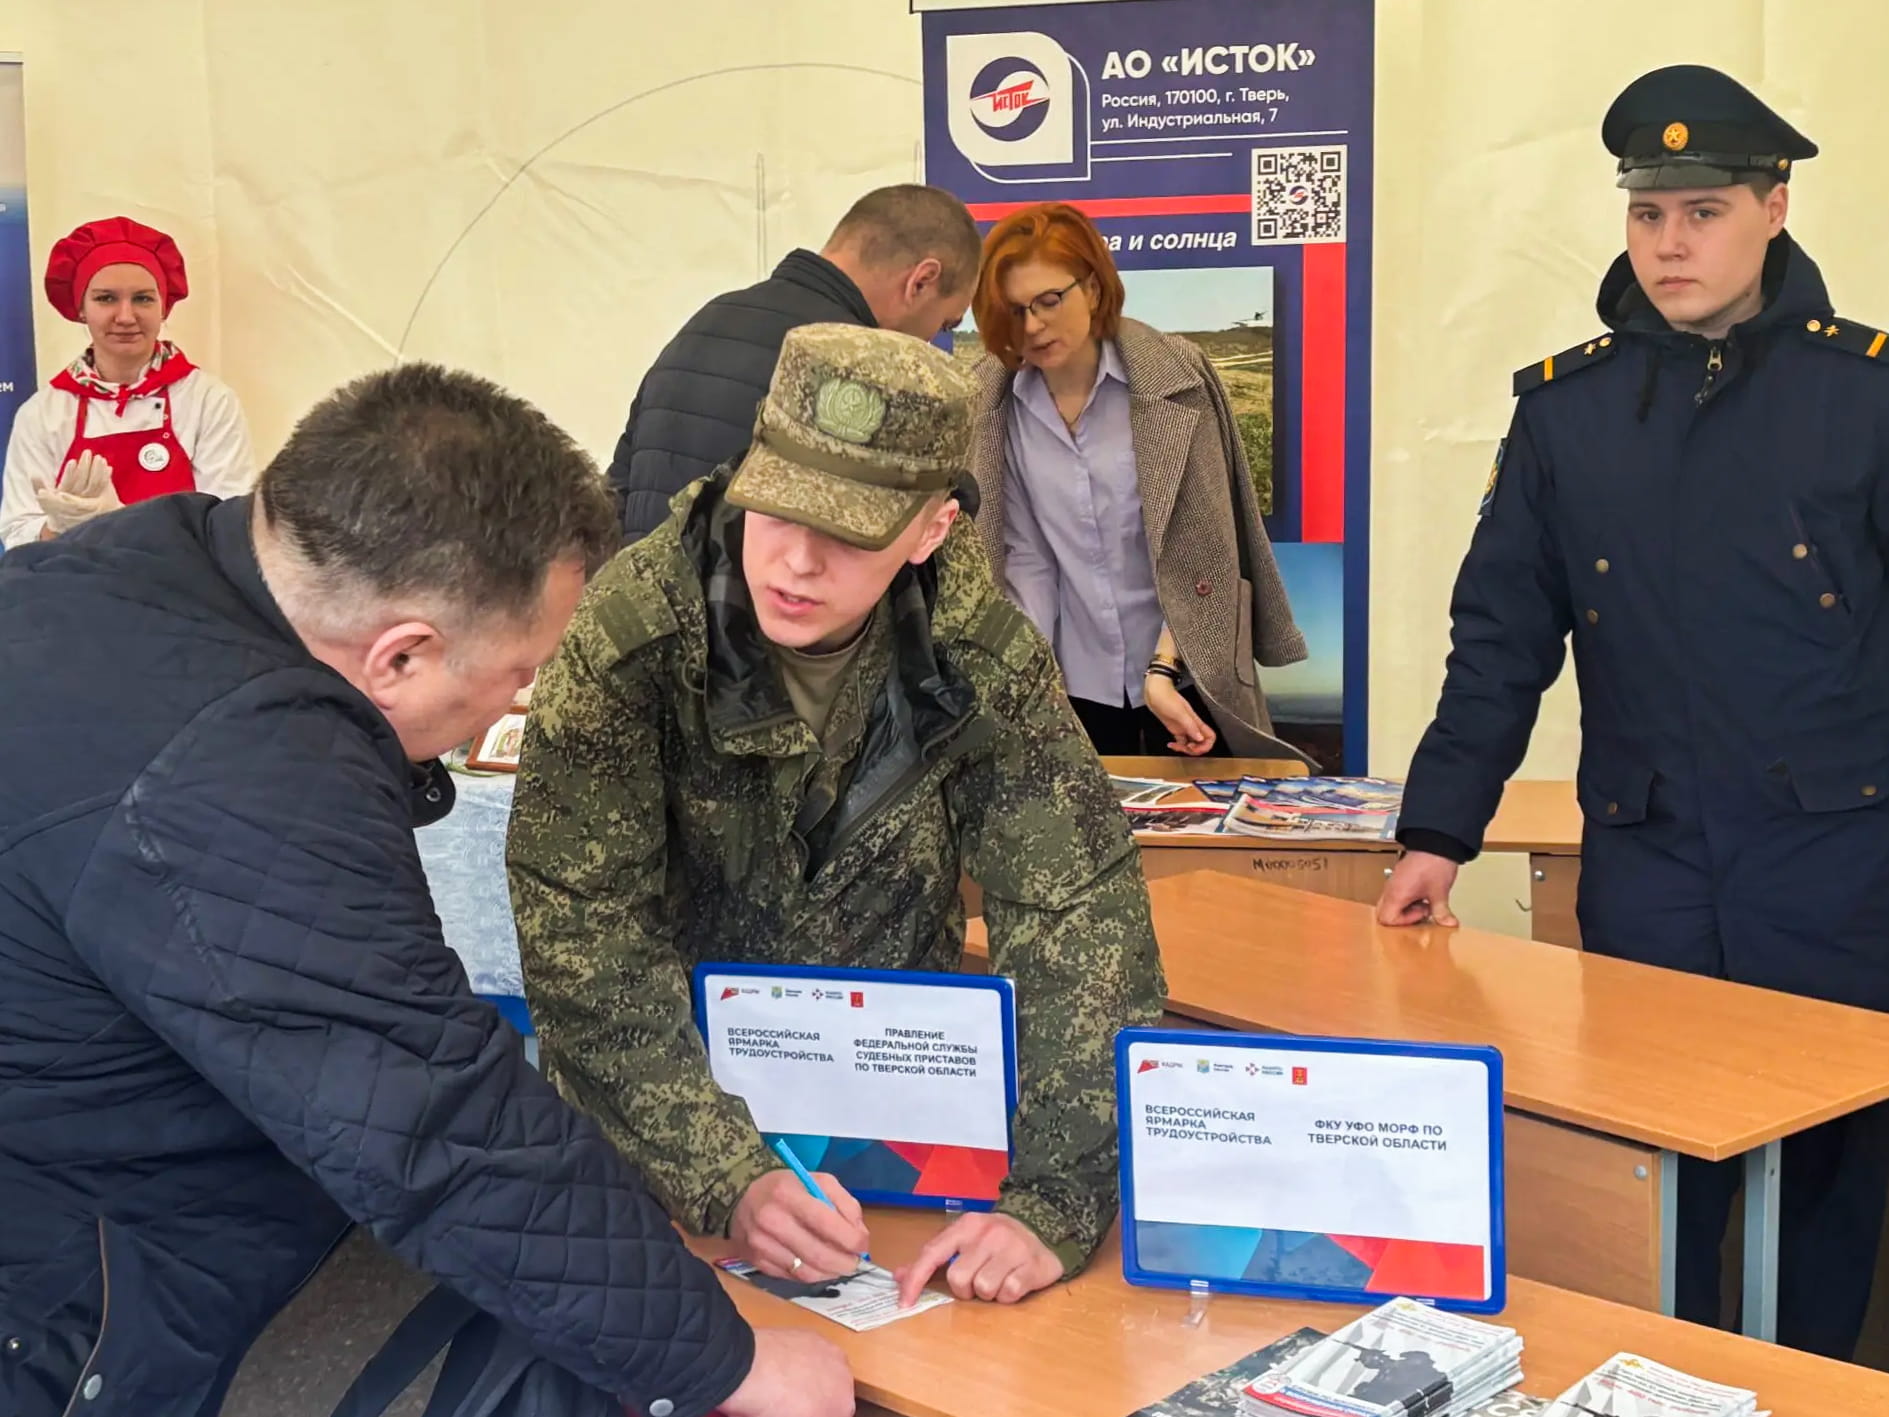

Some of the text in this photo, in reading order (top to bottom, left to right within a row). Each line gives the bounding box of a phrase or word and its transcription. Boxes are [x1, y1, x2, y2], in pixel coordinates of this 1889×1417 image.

[1101, 42, 1316, 80] АО «ИСТОК»
[1102, 86, 1290, 108] Россия, 170100, г. Тверь,
[1102, 108, 1279, 132] ул. Индустриальная, 7
[1128, 234, 1145, 250] и
[1150, 231, 1238, 251] солнца
[727, 1027, 820, 1041] ВСЕРОССИЙСКАЯ
[885, 1027, 945, 1040] ПРАВЛЕНИЕ
[728, 1037, 780, 1048] ЯРМАРКА
[853, 1038, 978, 1054] ФЕДЕРАЛЬНОЙ СЛУЖБЫ
[729, 1047, 834, 1062] ТРУДОУСТРОЙСТВА
[856, 1050, 976, 1066] СУДЕБНЫХ ПРИСТАВОВ
[854, 1062, 977, 1077] ПО ТВЕРСКОЙ ОБЛАСТИ
[1145, 1104, 1256, 1121] ВСЕРОССИЙСКАЯ
[1145, 1116, 1207, 1129] ЯРМАРКА
[1314, 1119, 1443, 1136] ФКУ УФО МОРФ ПО
[1146, 1126, 1273, 1145] ТРУДОУСТРОЙСТВА
[1307, 1132, 1447, 1151] ТВЕРСКОЙ ОБЛАСТИ
